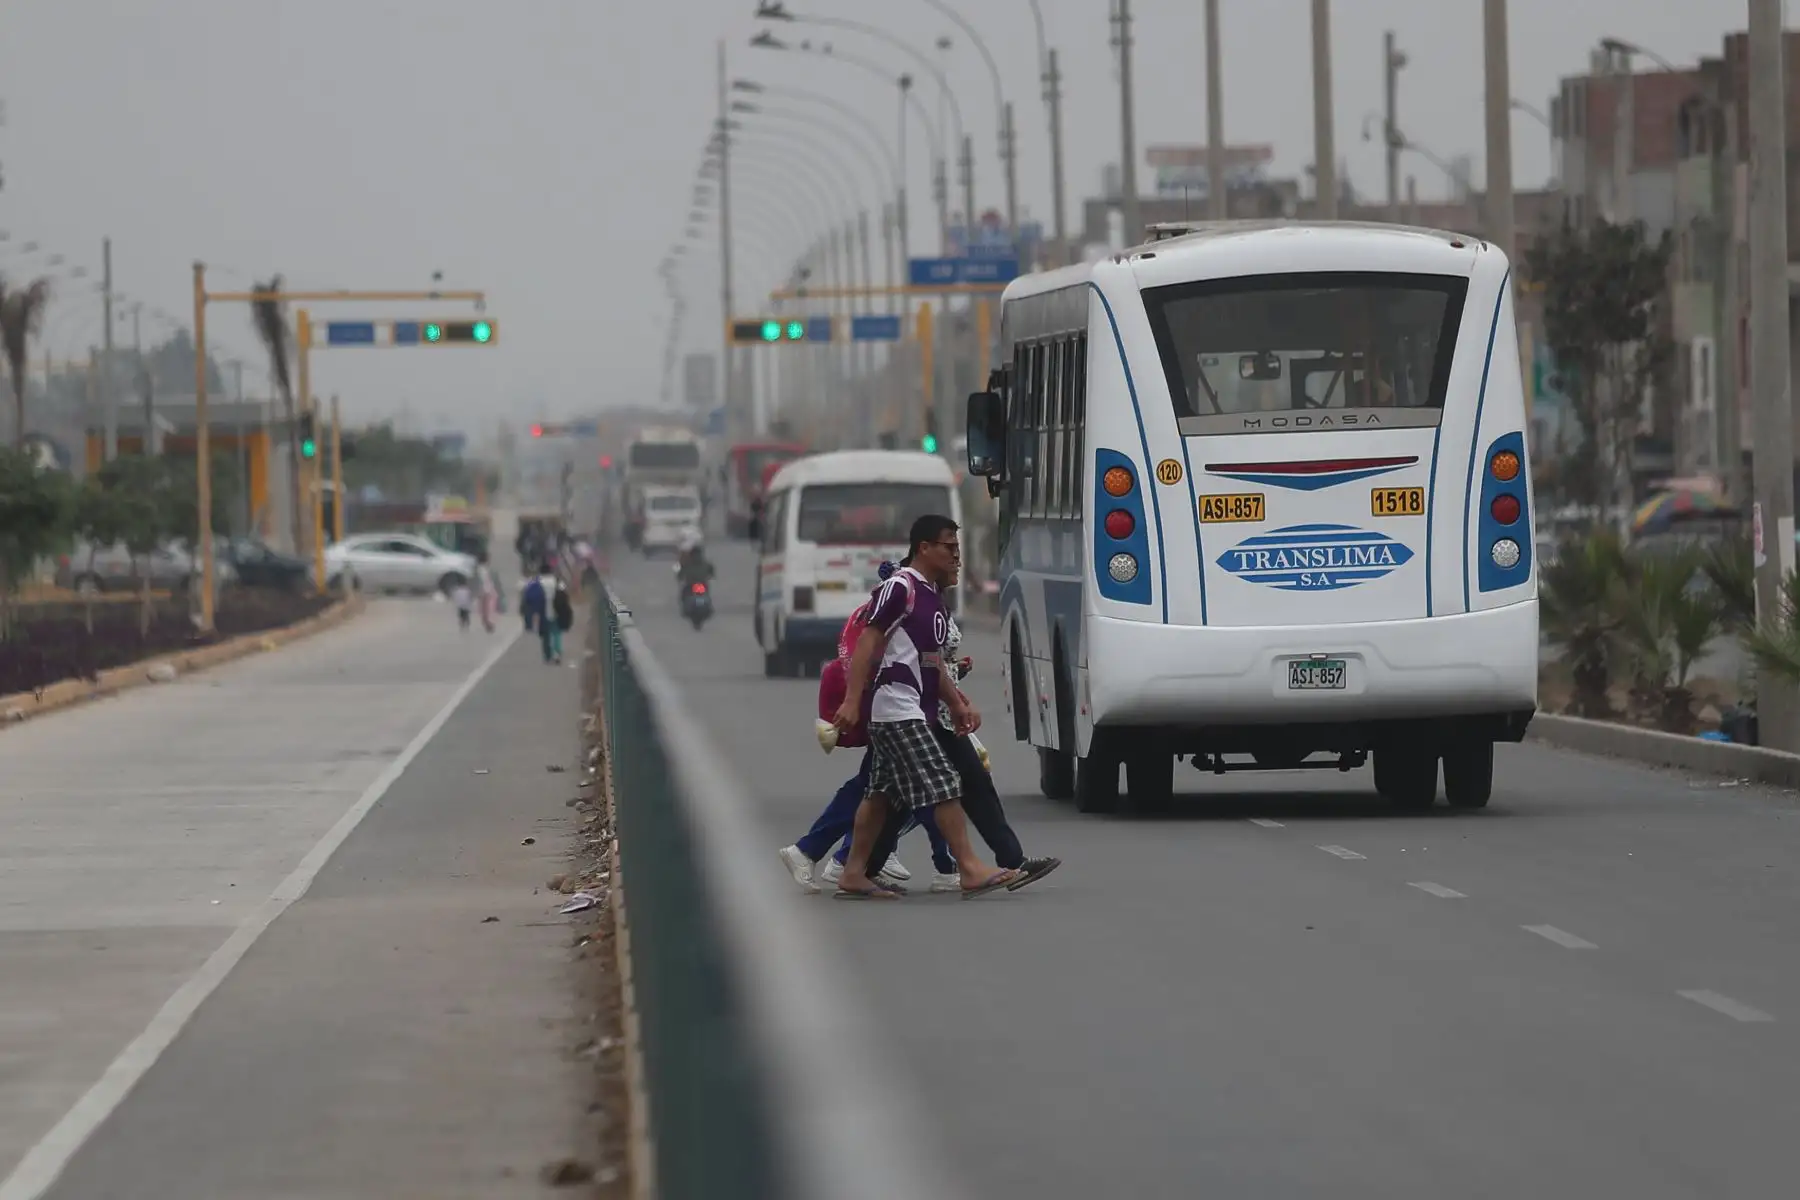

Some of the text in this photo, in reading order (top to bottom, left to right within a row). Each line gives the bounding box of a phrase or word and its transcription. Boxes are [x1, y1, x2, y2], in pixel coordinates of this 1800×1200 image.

[1243, 413, 1381, 429] MODASA
[1159, 463, 1179, 481] 120
[1203, 497, 1261, 520] ASI-857
[1375, 490, 1421, 513] 1518
[1233, 545, 1397, 571] TRANSLIMA
[1300, 572, 1332, 587] S.A
[1291, 667, 1344, 685] ASI-857
